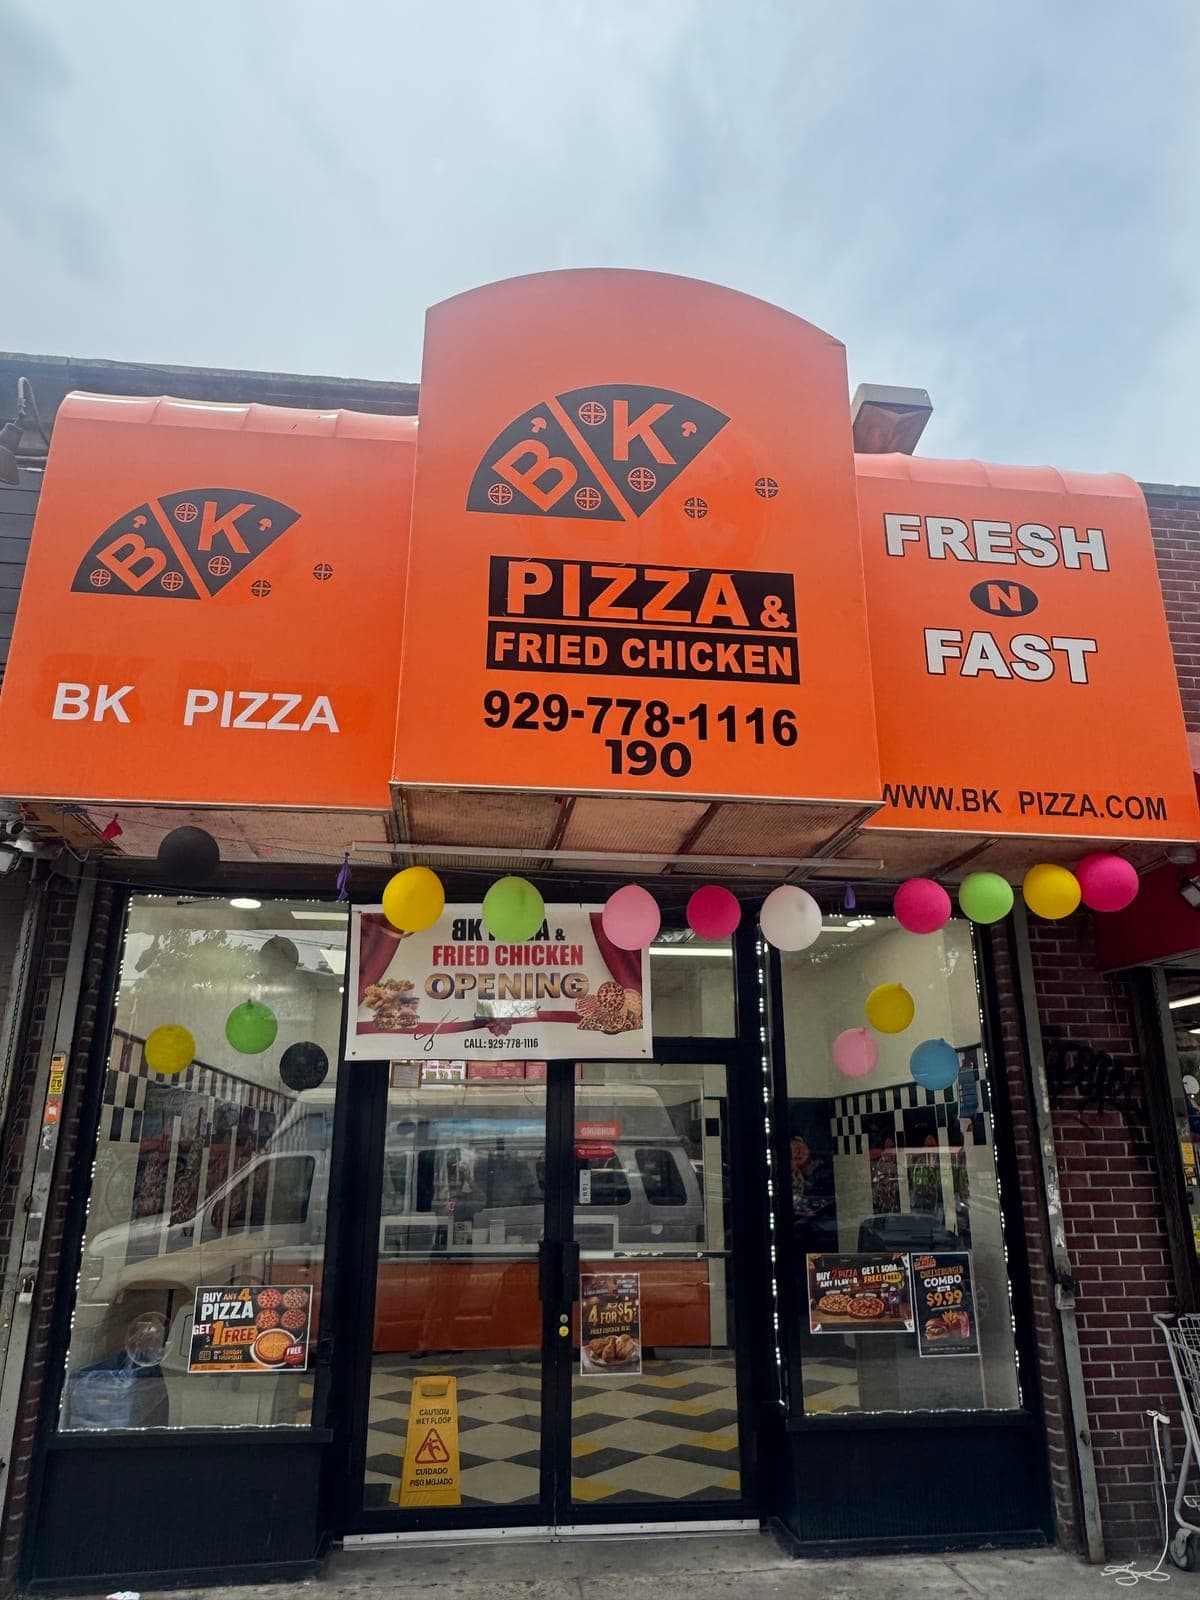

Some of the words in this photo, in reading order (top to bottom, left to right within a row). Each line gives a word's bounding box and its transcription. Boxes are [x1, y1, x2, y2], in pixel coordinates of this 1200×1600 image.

[883, 513, 1110, 572] FRESH
[506, 560, 749, 627] PIZZA
[760, 595, 791, 629] &
[987, 583, 1022, 611] N
[494, 631, 608, 667] FRIED
[621, 638, 793, 677] CHICKEN
[923, 628, 1098, 684] FAST
[52, 682, 135, 724] BK
[183, 688, 340, 733] PIZZA
[483, 690, 799, 747] 929-778-1116
[604, 740, 692, 778] 190
[1018, 790, 1168, 821] PIZZA.COM
[432, 944, 489, 966] FRIED
[495, 944, 584, 966] CHICKEN
[424, 972, 590, 1000] OPENING
[464, 1038, 487, 1049] CALL:
[488, 1038, 539, 1049] 929-778-1116
[816, 1271, 830, 1281] BUY
[924, 1274, 962, 1288] COMBO
[203, 1292, 222, 1303] BUY
[239, 1287, 251, 1301] 4
[926, 1290, 963, 1306] $9.99
[201, 1301, 254, 1321] PIZZA
[600, 1311, 617, 1324] FOR
[193, 1323, 211, 1335] GET
[212, 1320, 224, 1346] 1
[224, 1327, 255, 1343] FREE
[419, 1408, 450, 1416] CAUTION
[430, 1416, 452, 1424] FLOOR
[416, 1467, 448, 1475] CUIDADO
[425, 1478, 453, 1486] MOJADO
